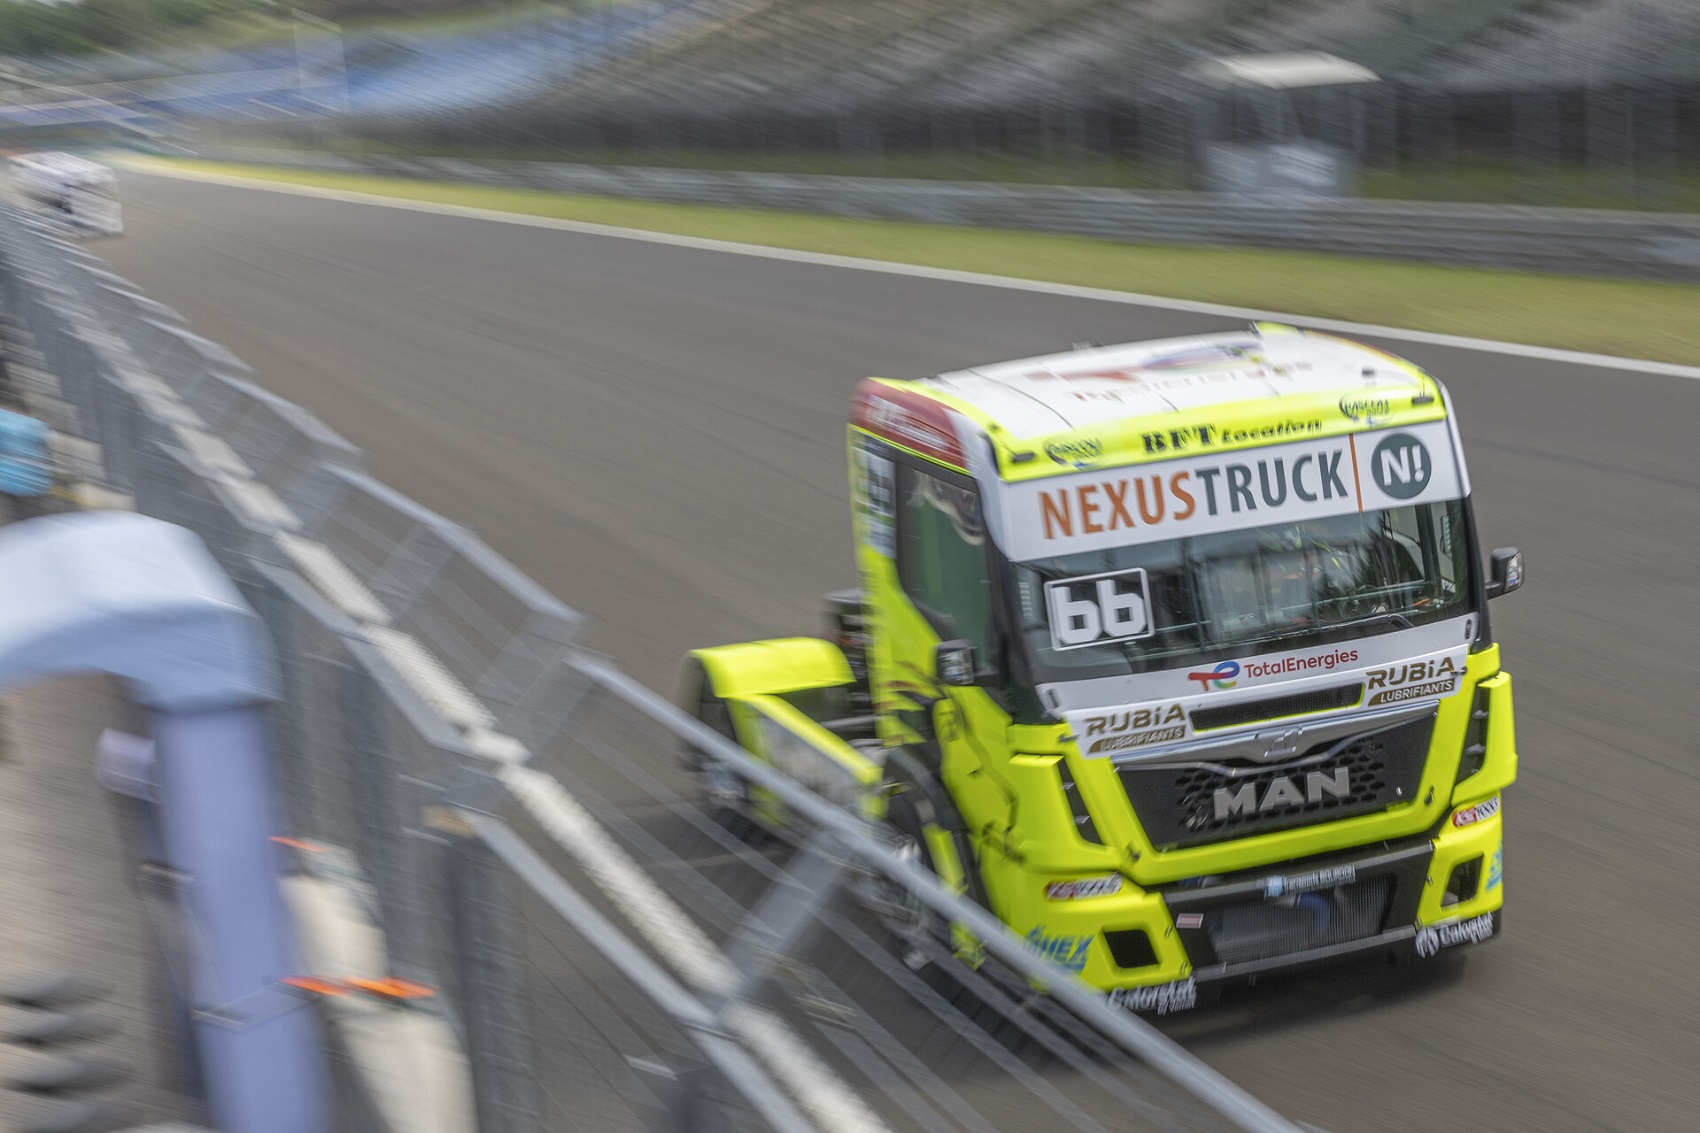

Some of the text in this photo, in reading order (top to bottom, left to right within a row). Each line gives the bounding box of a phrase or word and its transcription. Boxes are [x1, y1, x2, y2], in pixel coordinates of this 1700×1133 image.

[1037, 449, 1349, 539] NEXUSTRUCK
[1244, 649, 1358, 678] TotalEnergies
[1380, 680, 1453, 703] LUBRIFIANTS
[1100, 726, 1184, 751] LUBRIFIANTS
[1213, 766, 1350, 821] MAN
